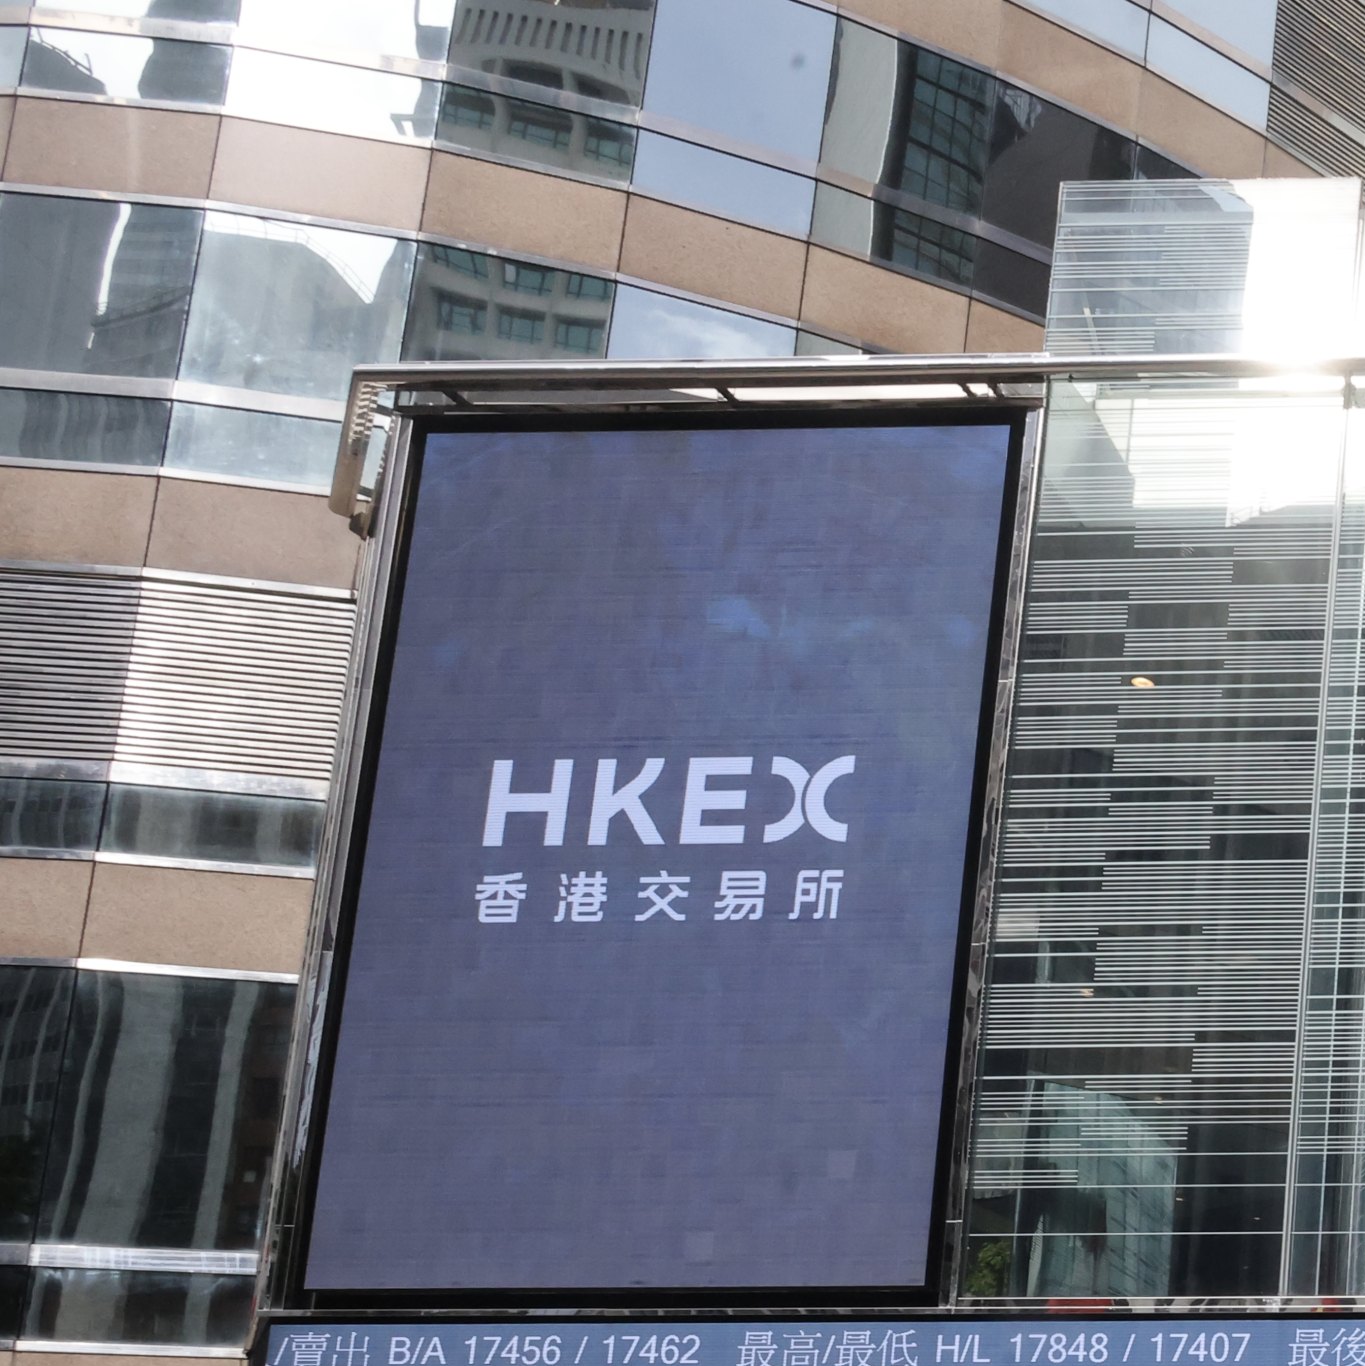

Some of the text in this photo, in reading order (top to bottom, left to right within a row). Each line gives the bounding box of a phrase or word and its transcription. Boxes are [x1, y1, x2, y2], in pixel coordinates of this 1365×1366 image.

[482, 755, 856, 846] HKEX
[475, 869, 844, 923] 香港交易所
[389, 1336, 446, 1365] B/A
[464, 1335, 562, 1365] 17456
[603, 1335, 700, 1365] 17462
[936, 1334, 991, 1363] H/L
[1010, 1332, 1108, 1363] 17848
[1150, 1332, 1251, 1363] 17407
